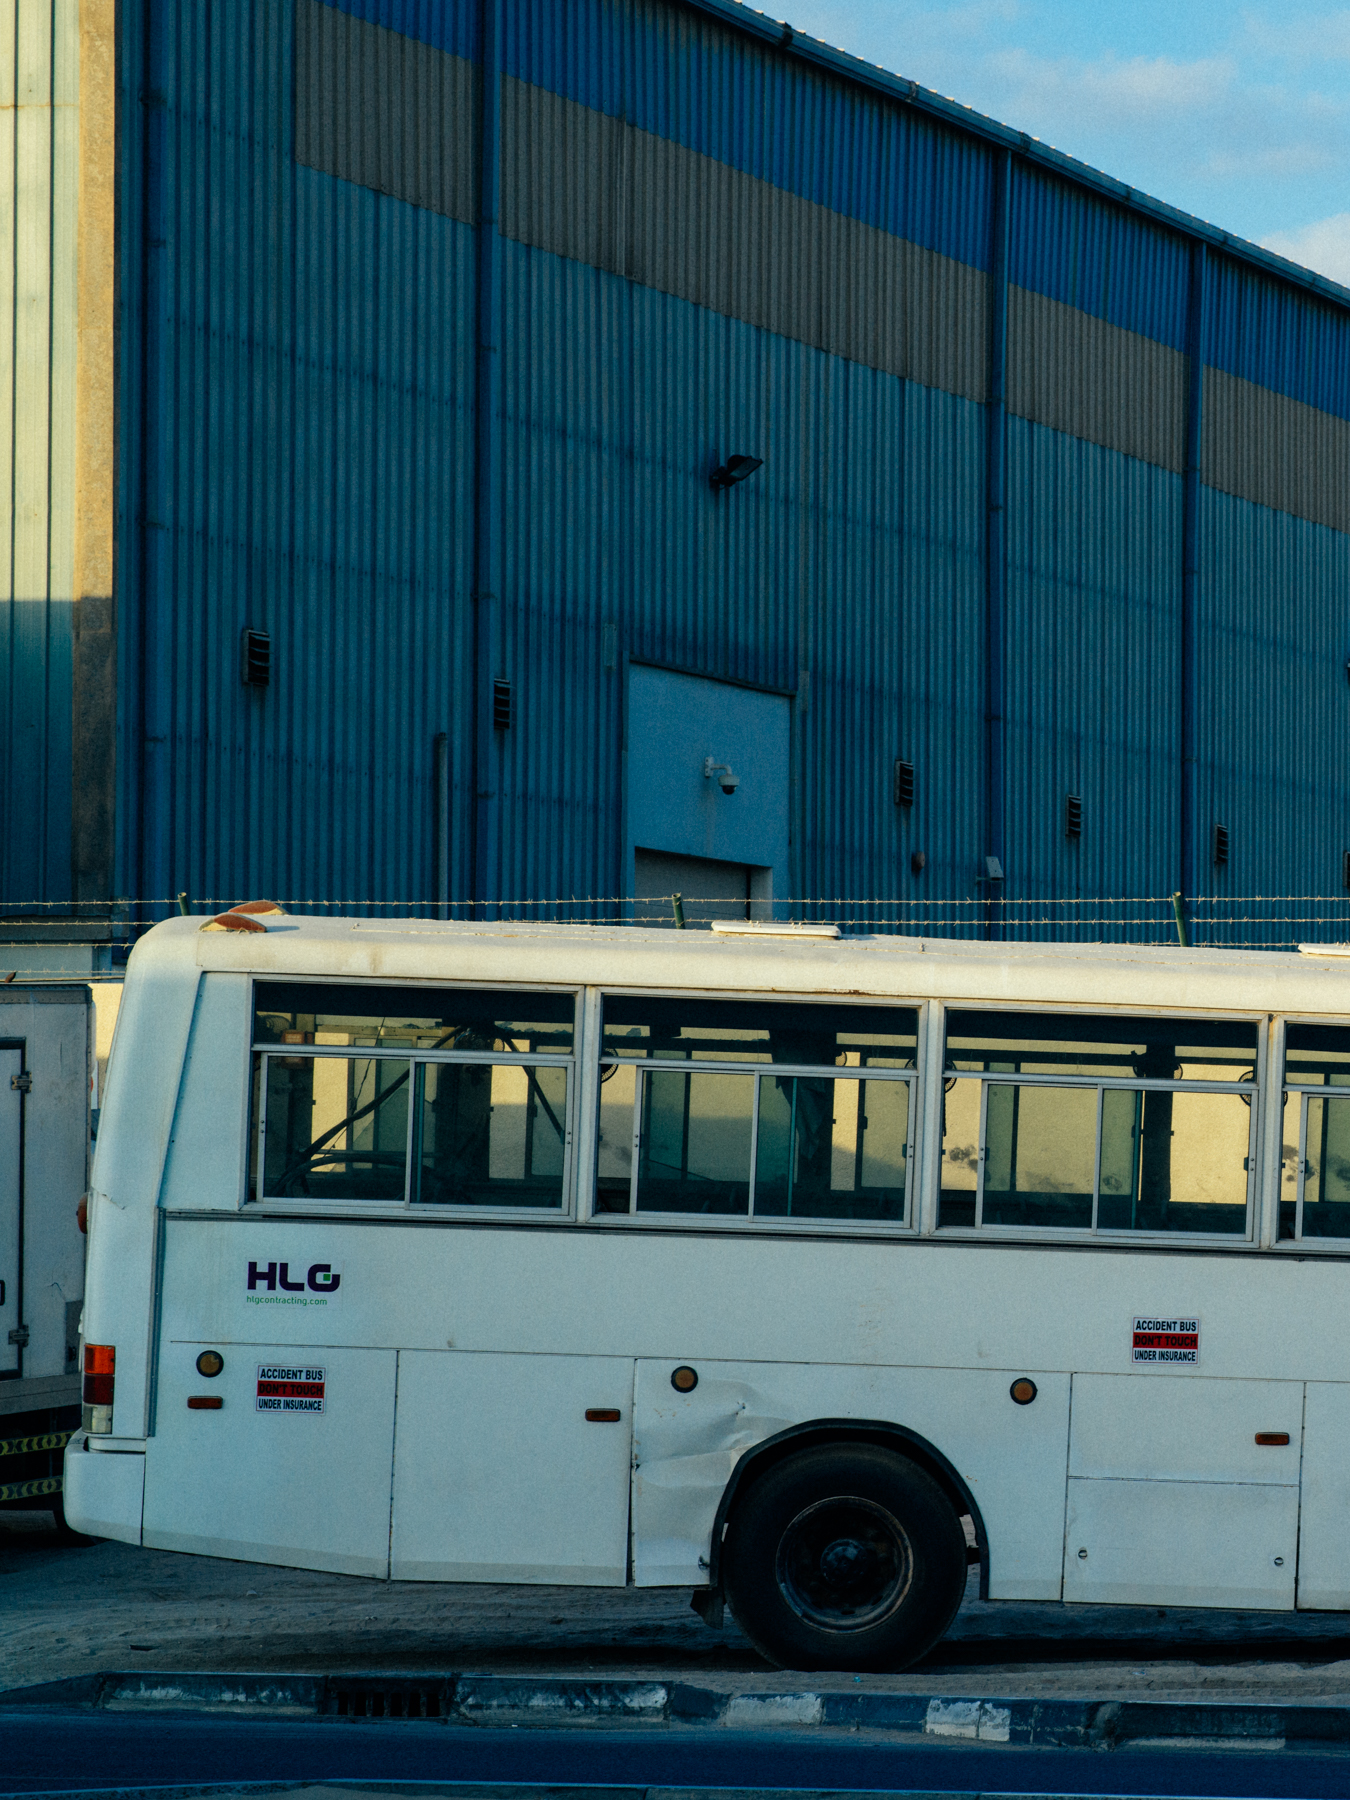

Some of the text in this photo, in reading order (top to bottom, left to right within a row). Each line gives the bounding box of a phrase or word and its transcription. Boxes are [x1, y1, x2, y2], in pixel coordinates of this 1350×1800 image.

[247, 1261, 341, 1292] HLG
[246, 1295, 328, 1306] hlgcontracting.com
[1136, 1320, 1196, 1332] ACCIDENT BUS
[1134, 1335, 1196, 1346] DON'T TOUCH
[1134, 1350, 1196, 1362] UNDER INSURANCE
[260, 1368, 323, 1380] ACCIDENT BUS
[259, 1383, 323, 1396] DON'T TOUCH
[259, 1398, 322, 1410] UNDER INSURANCE
